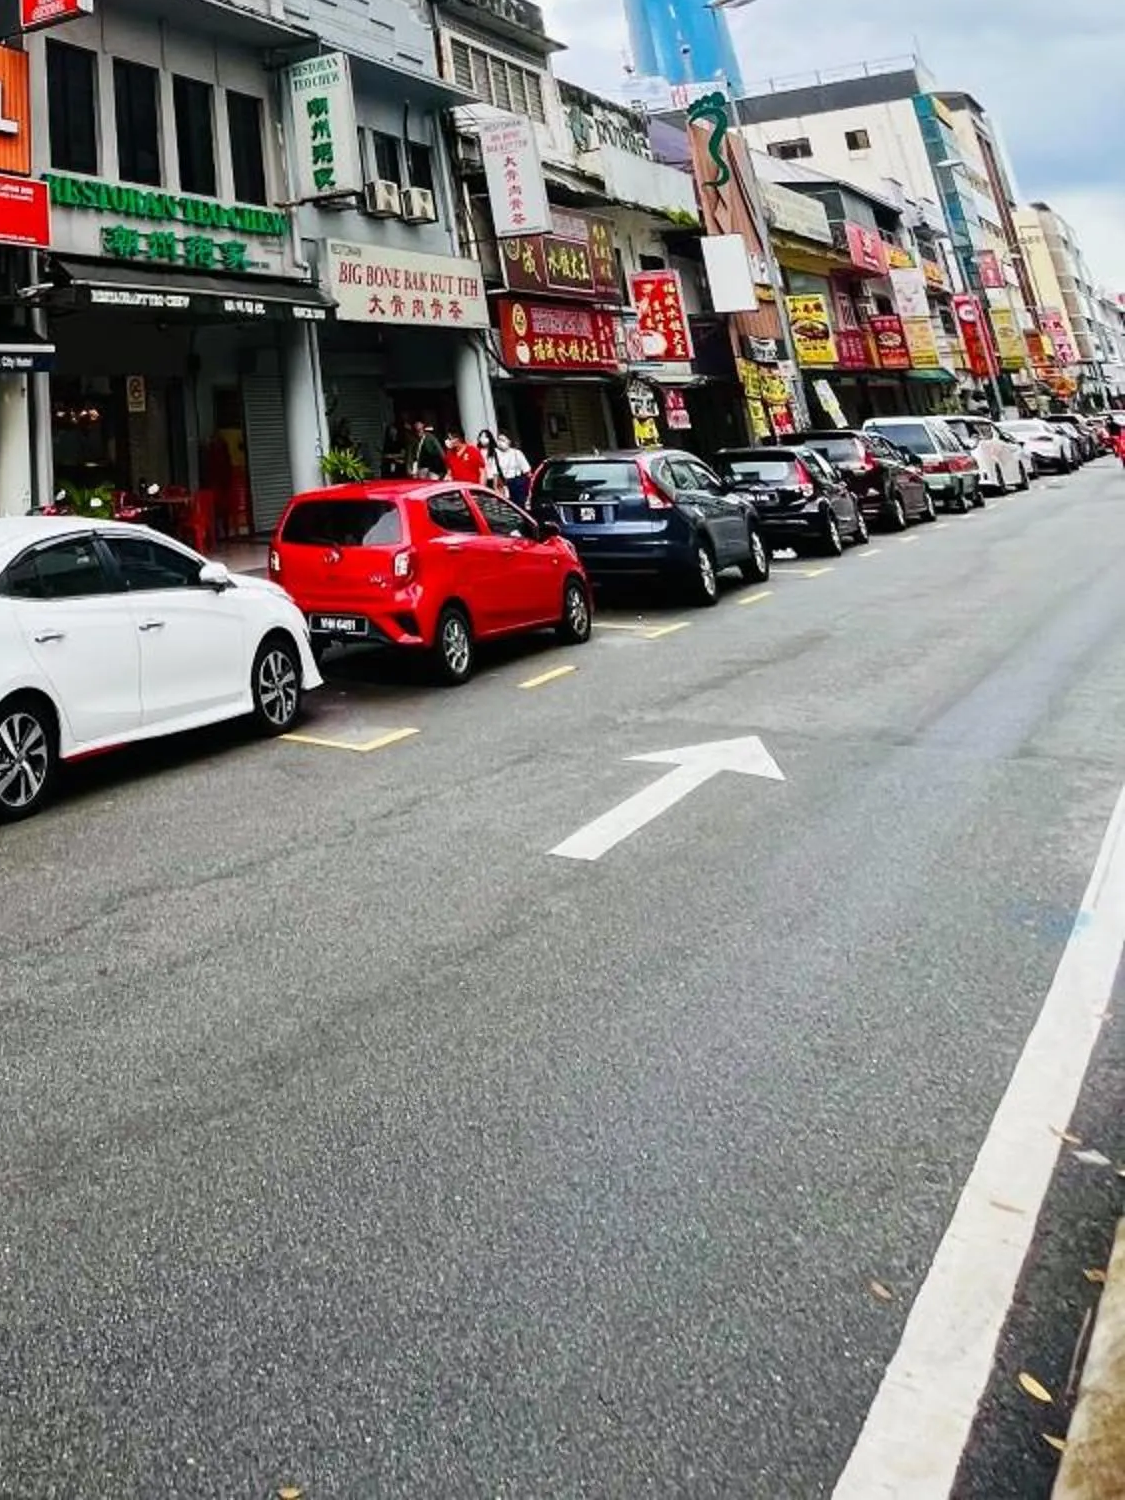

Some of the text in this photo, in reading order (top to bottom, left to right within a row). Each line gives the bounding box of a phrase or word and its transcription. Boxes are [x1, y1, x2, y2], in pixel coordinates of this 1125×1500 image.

[339, 261, 478, 297] BIG BONE BAK KUT TEH
